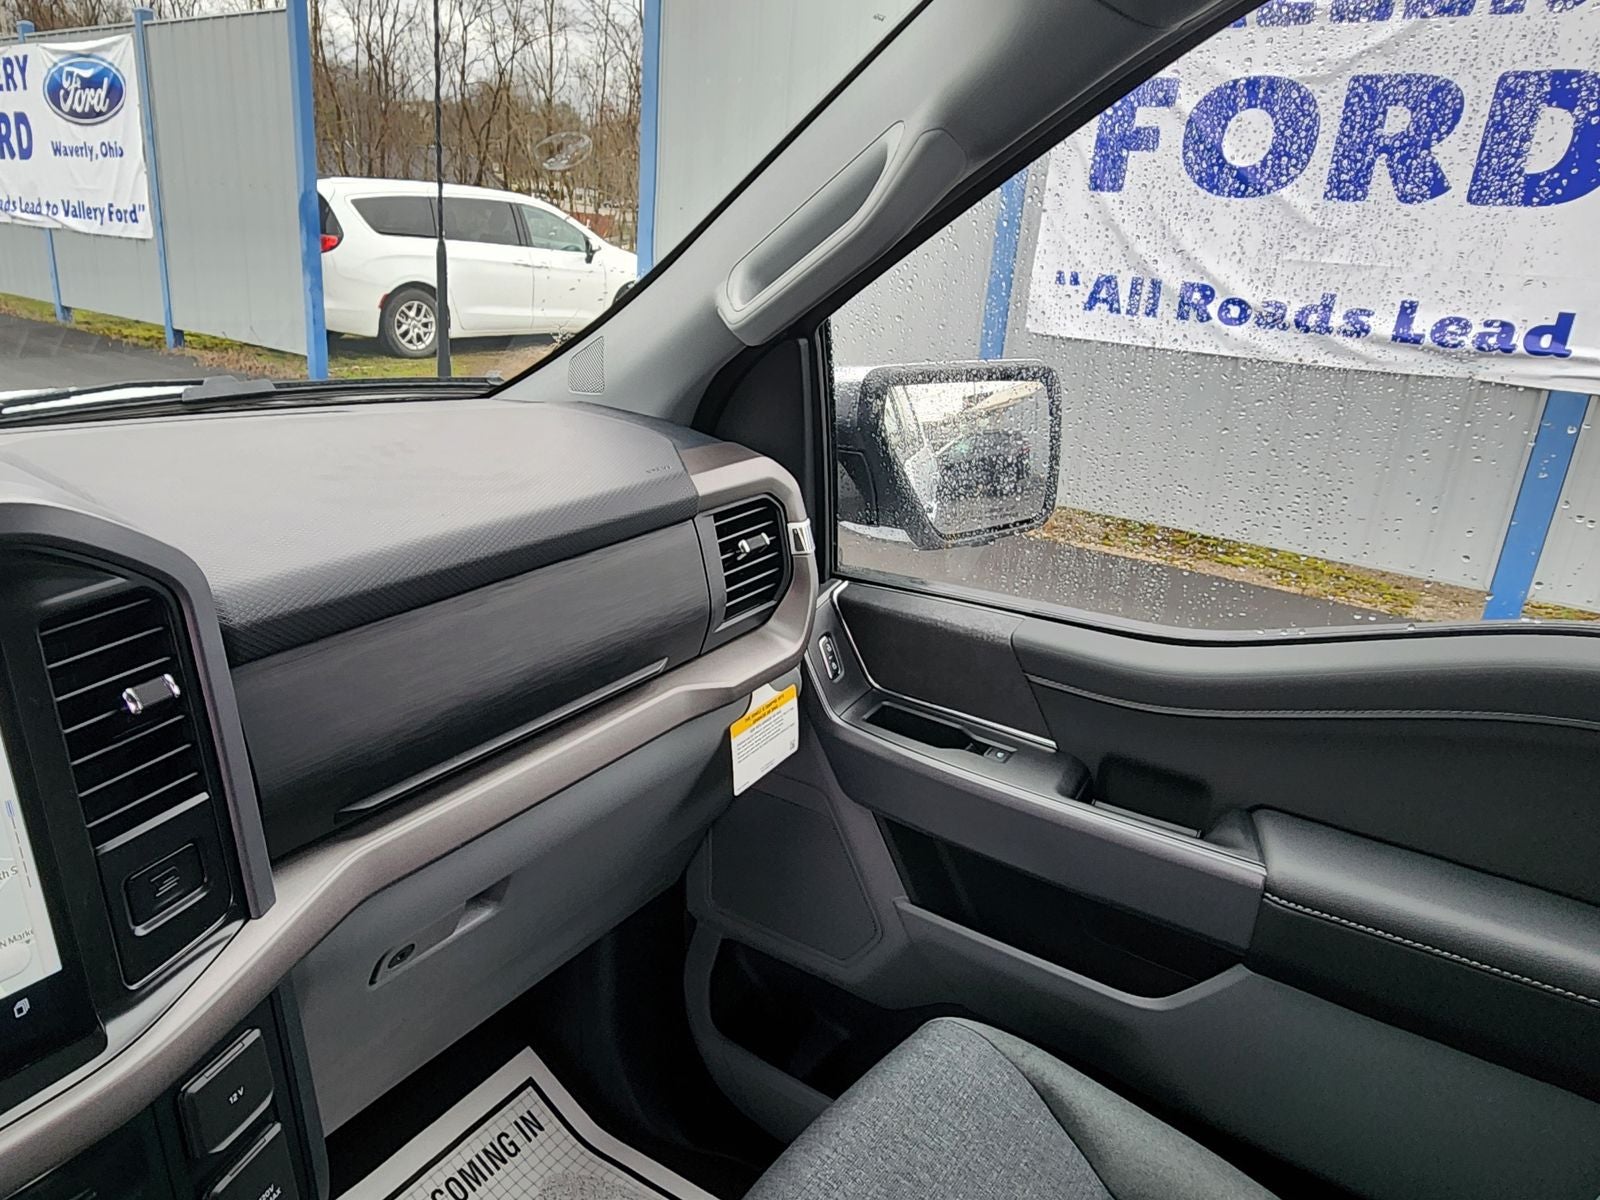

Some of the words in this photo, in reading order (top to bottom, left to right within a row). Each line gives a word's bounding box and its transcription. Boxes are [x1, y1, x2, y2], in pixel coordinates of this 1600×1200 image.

[0, 54, 28, 92] RY
[59, 65, 110, 113] Ford
[51, 140, 98, 162] Waverly,
[100, 140, 124, 159] Ohio
[1088, 69, 1600, 207] FORD
[19, 195, 42, 216] Lead
[45, 200, 59, 217] to
[61, 199, 105, 226] Vallery
[108, 202, 145, 224] Ford"
[1055, 270, 1163, 319] "All
[1177, 281, 1375, 339] Roads
[1391, 300, 1576, 359] Lead
[513, 1109, 545, 1143] IN
